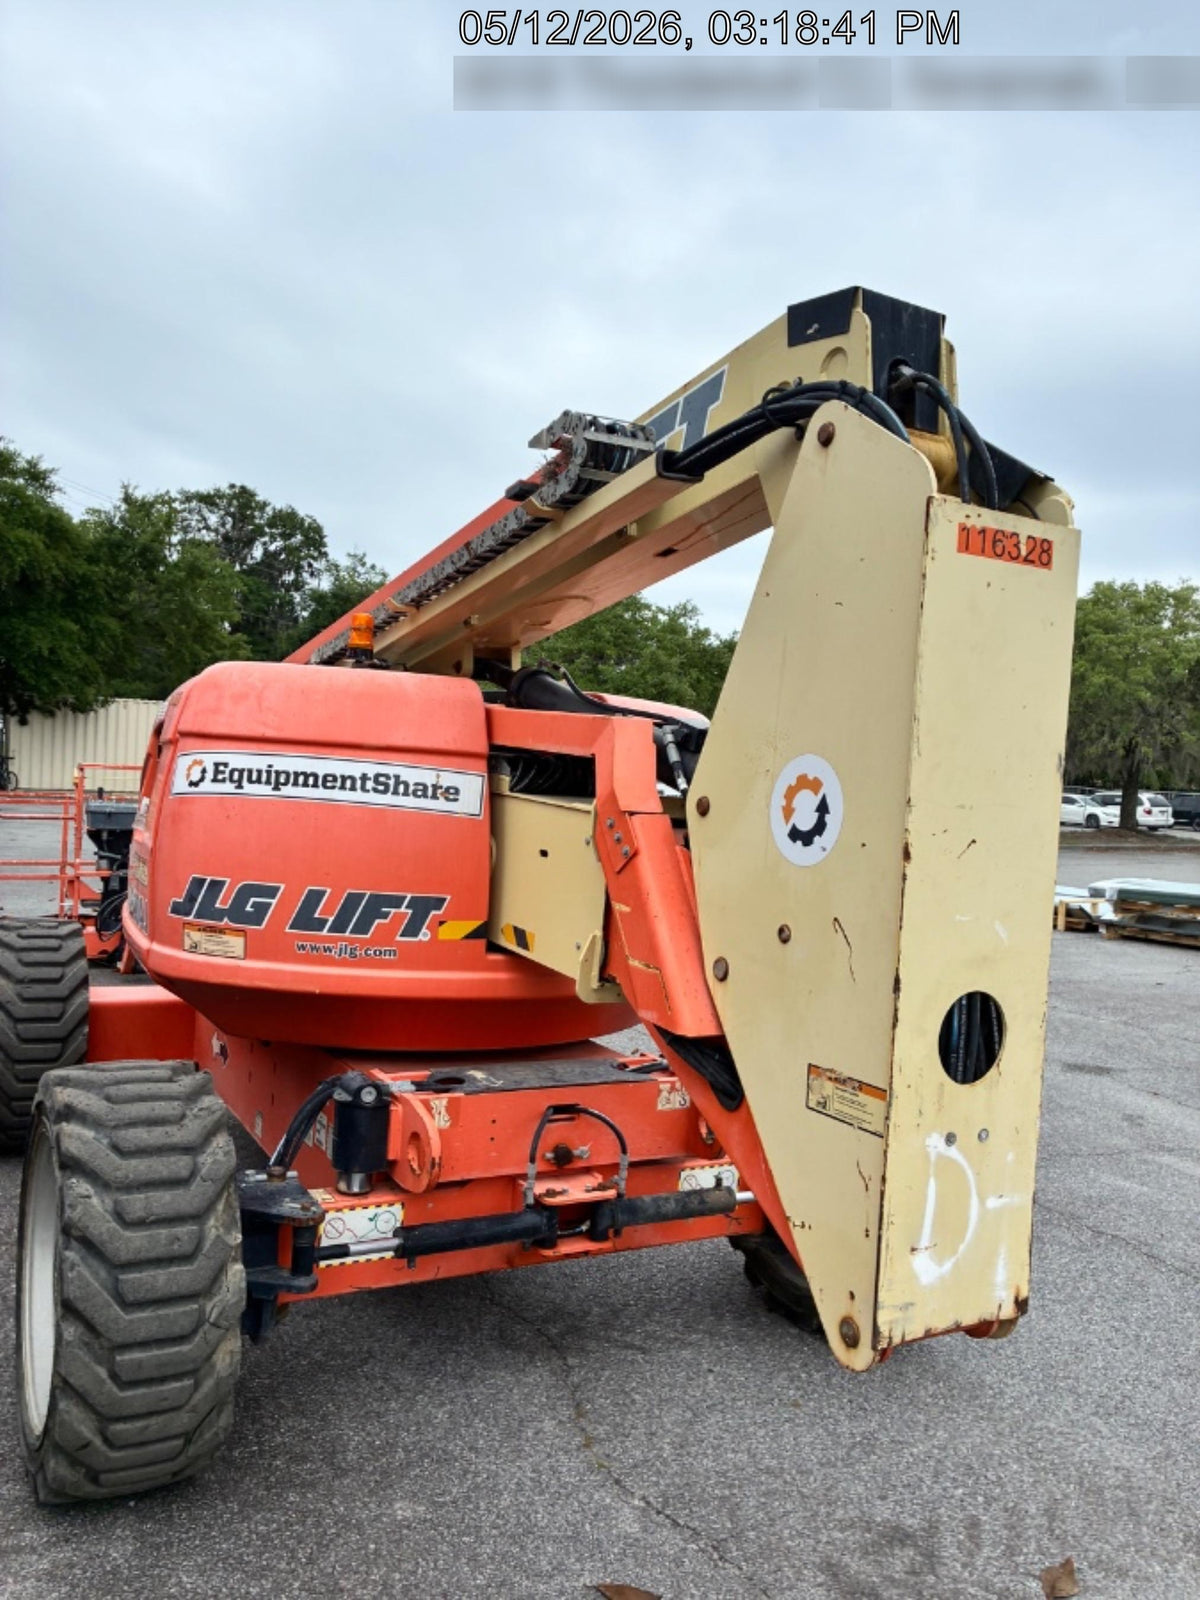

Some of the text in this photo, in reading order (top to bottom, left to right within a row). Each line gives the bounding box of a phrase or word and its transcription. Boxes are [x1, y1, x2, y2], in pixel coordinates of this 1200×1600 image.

[960, 526, 1052, 567] 116328
[211, 762, 460, 802] EquipmentShare
[168, 875, 285, 928] JLG
[286, 887, 450, 940] LIFT
[295, 942, 398, 959] www.jlg.com
